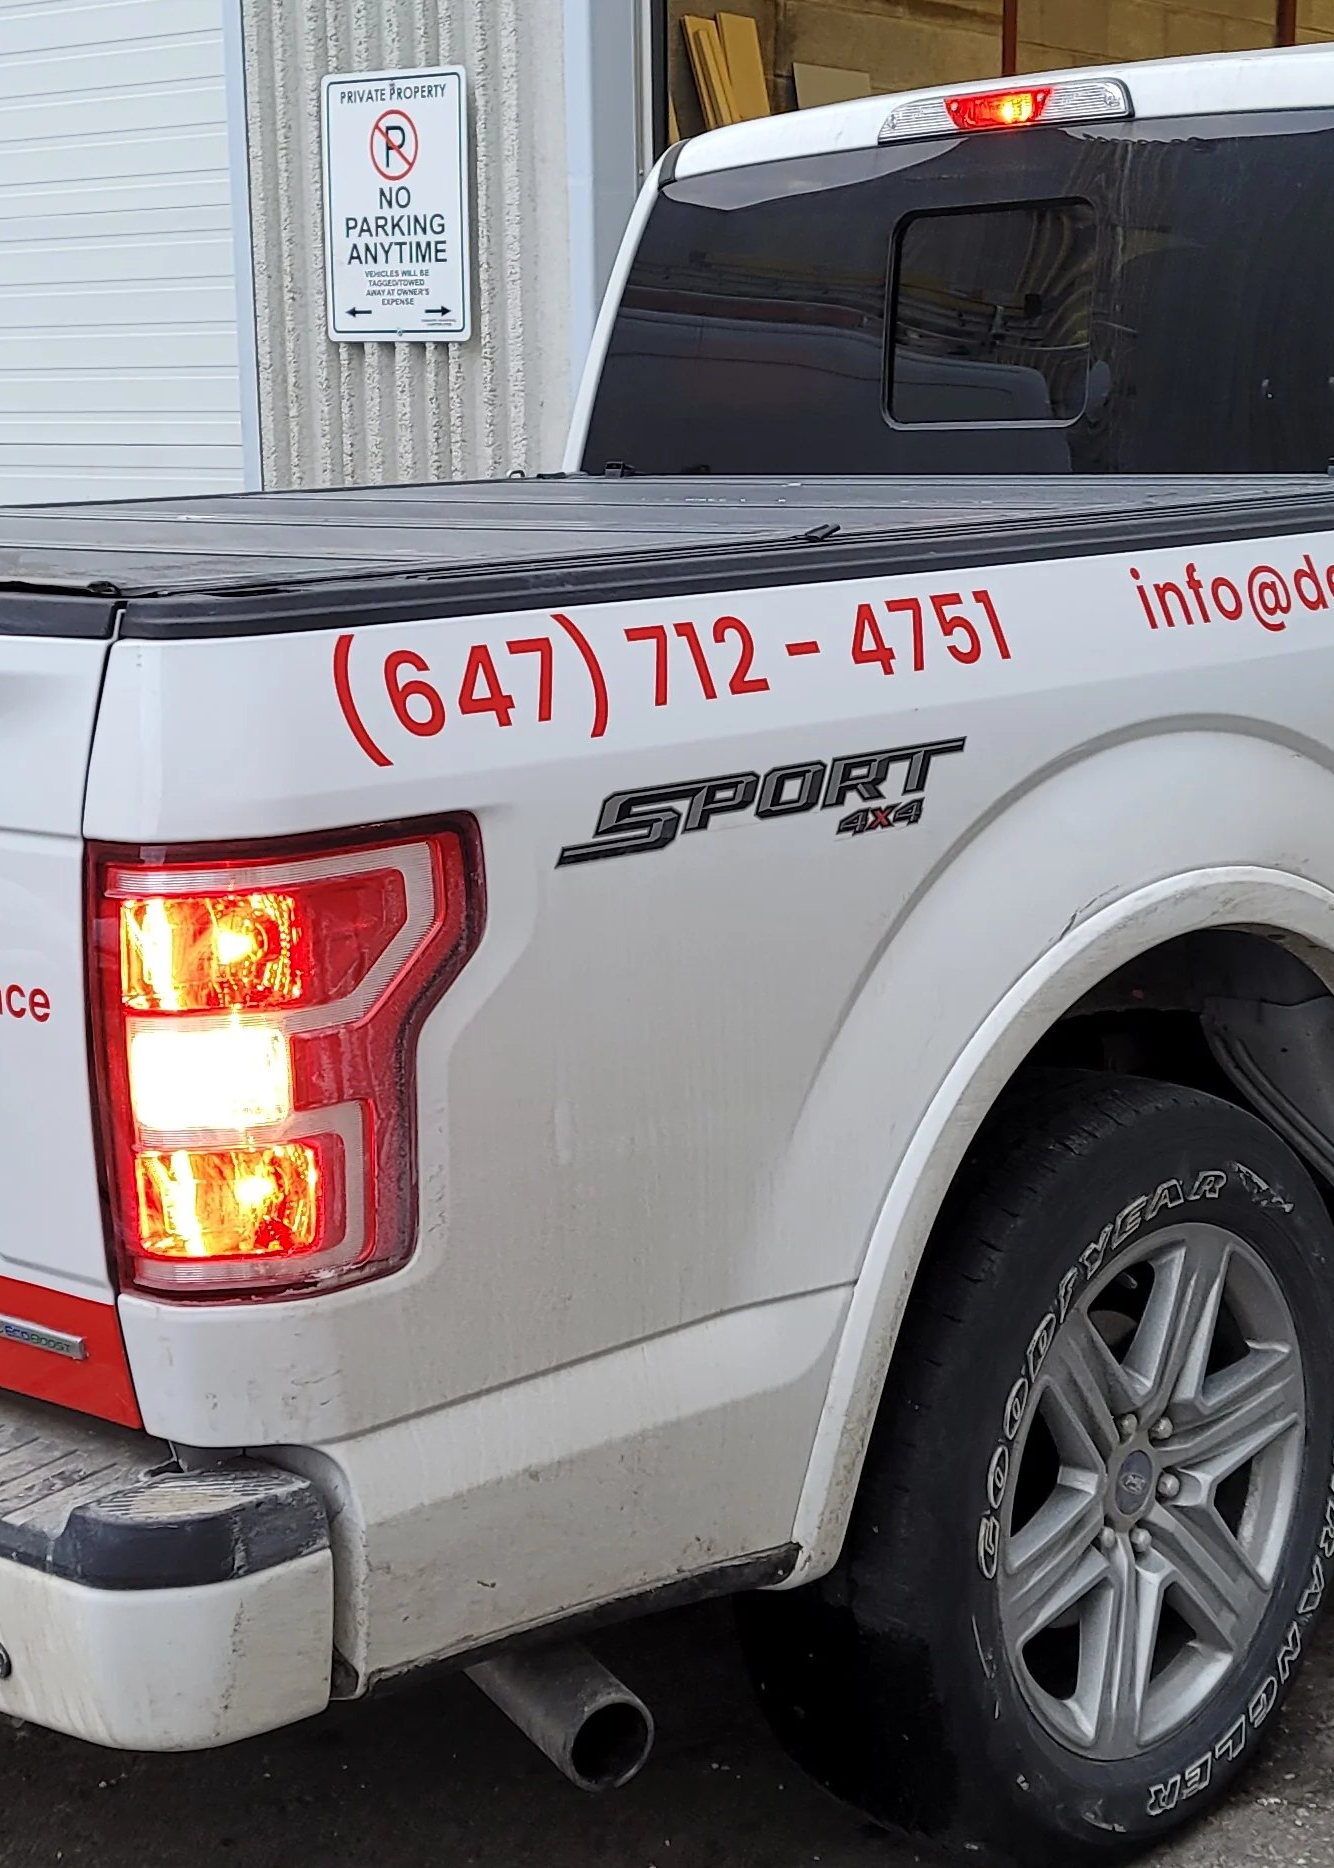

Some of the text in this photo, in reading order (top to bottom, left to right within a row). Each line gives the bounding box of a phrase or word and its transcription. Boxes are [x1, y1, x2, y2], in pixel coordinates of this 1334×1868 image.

[340, 84, 447, 104] PRIVATE PROPERTY
[379, 186, 411, 210] NO
[345, 213, 445, 239] PARKING
[347, 240, 448, 265] ANYTIME
[365, 268, 430, 278] VEHICLES WILL BE
[381, 298, 415, 306] EXPENSE
[333, 613, 609, 767] (647)
[623, 616, 771, 707] 712
[850, 589, 1013, 676] 4751
[554, 736, 967, 869] SPORT
